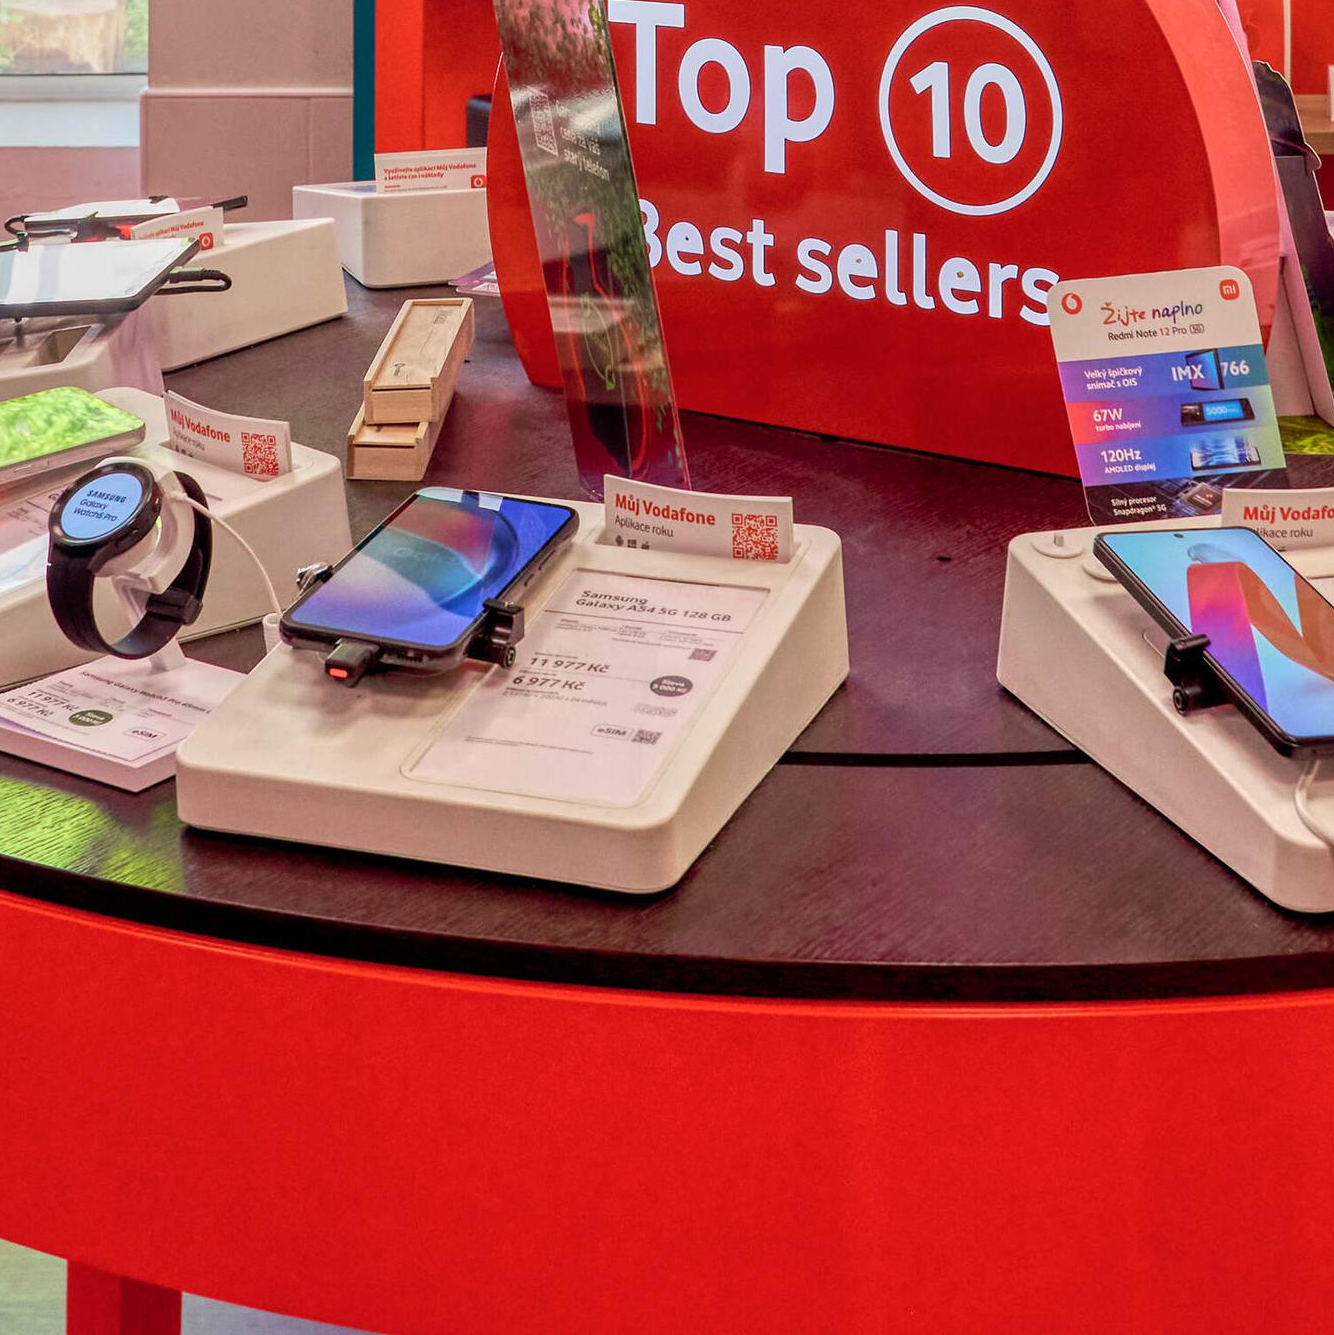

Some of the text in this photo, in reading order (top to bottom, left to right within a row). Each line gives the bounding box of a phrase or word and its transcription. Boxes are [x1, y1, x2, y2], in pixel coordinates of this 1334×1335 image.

[909, 61, 1027, 164] 10
[637, 198, 1060, 327] Best sellers
[1101, 301, 1203, 327] Žijte naplno
[1108, 330, 1135, 341] Redmi
[1135, 328, 1158, 340] Note
[1160, 327, 1170, 337] 12
[1172, 326, 1187, 336] Pro
[1084, 361, 1250, 382] Velký špičkový IMX 766
[1086, 378, 1115, 390] snímač
[1093, 408, 1123, 423] 67W
[170, 409, 231, 443] Můj Vodafone
[1100, 449, 1142, 463] 120Hz
[1104, 464, 1134, 474] AMOLED
[87, 490, 127, 503] SAMSUNG
[80, 498, 109, 511] Galaxy
[615, 493, 717, 526] Můj Vodafone
[103, 513, 118, 522] Pro
[1243, 505, 1276, 524] Můj
[615, 514, 674, 538] Aplikace roku
[1254, 527, 1314, 538] likace roku
[581, 590, 648, 606] Samsung
[575, 599, 732, 622] Galaxy A54 5G 128 GB
[554, 659, 586, 671] 977
[587, 663, 609, 674] Kč
[512, 675, 586, 691] 6 977 Kč
[596, 726, 627, 737] eSIM
